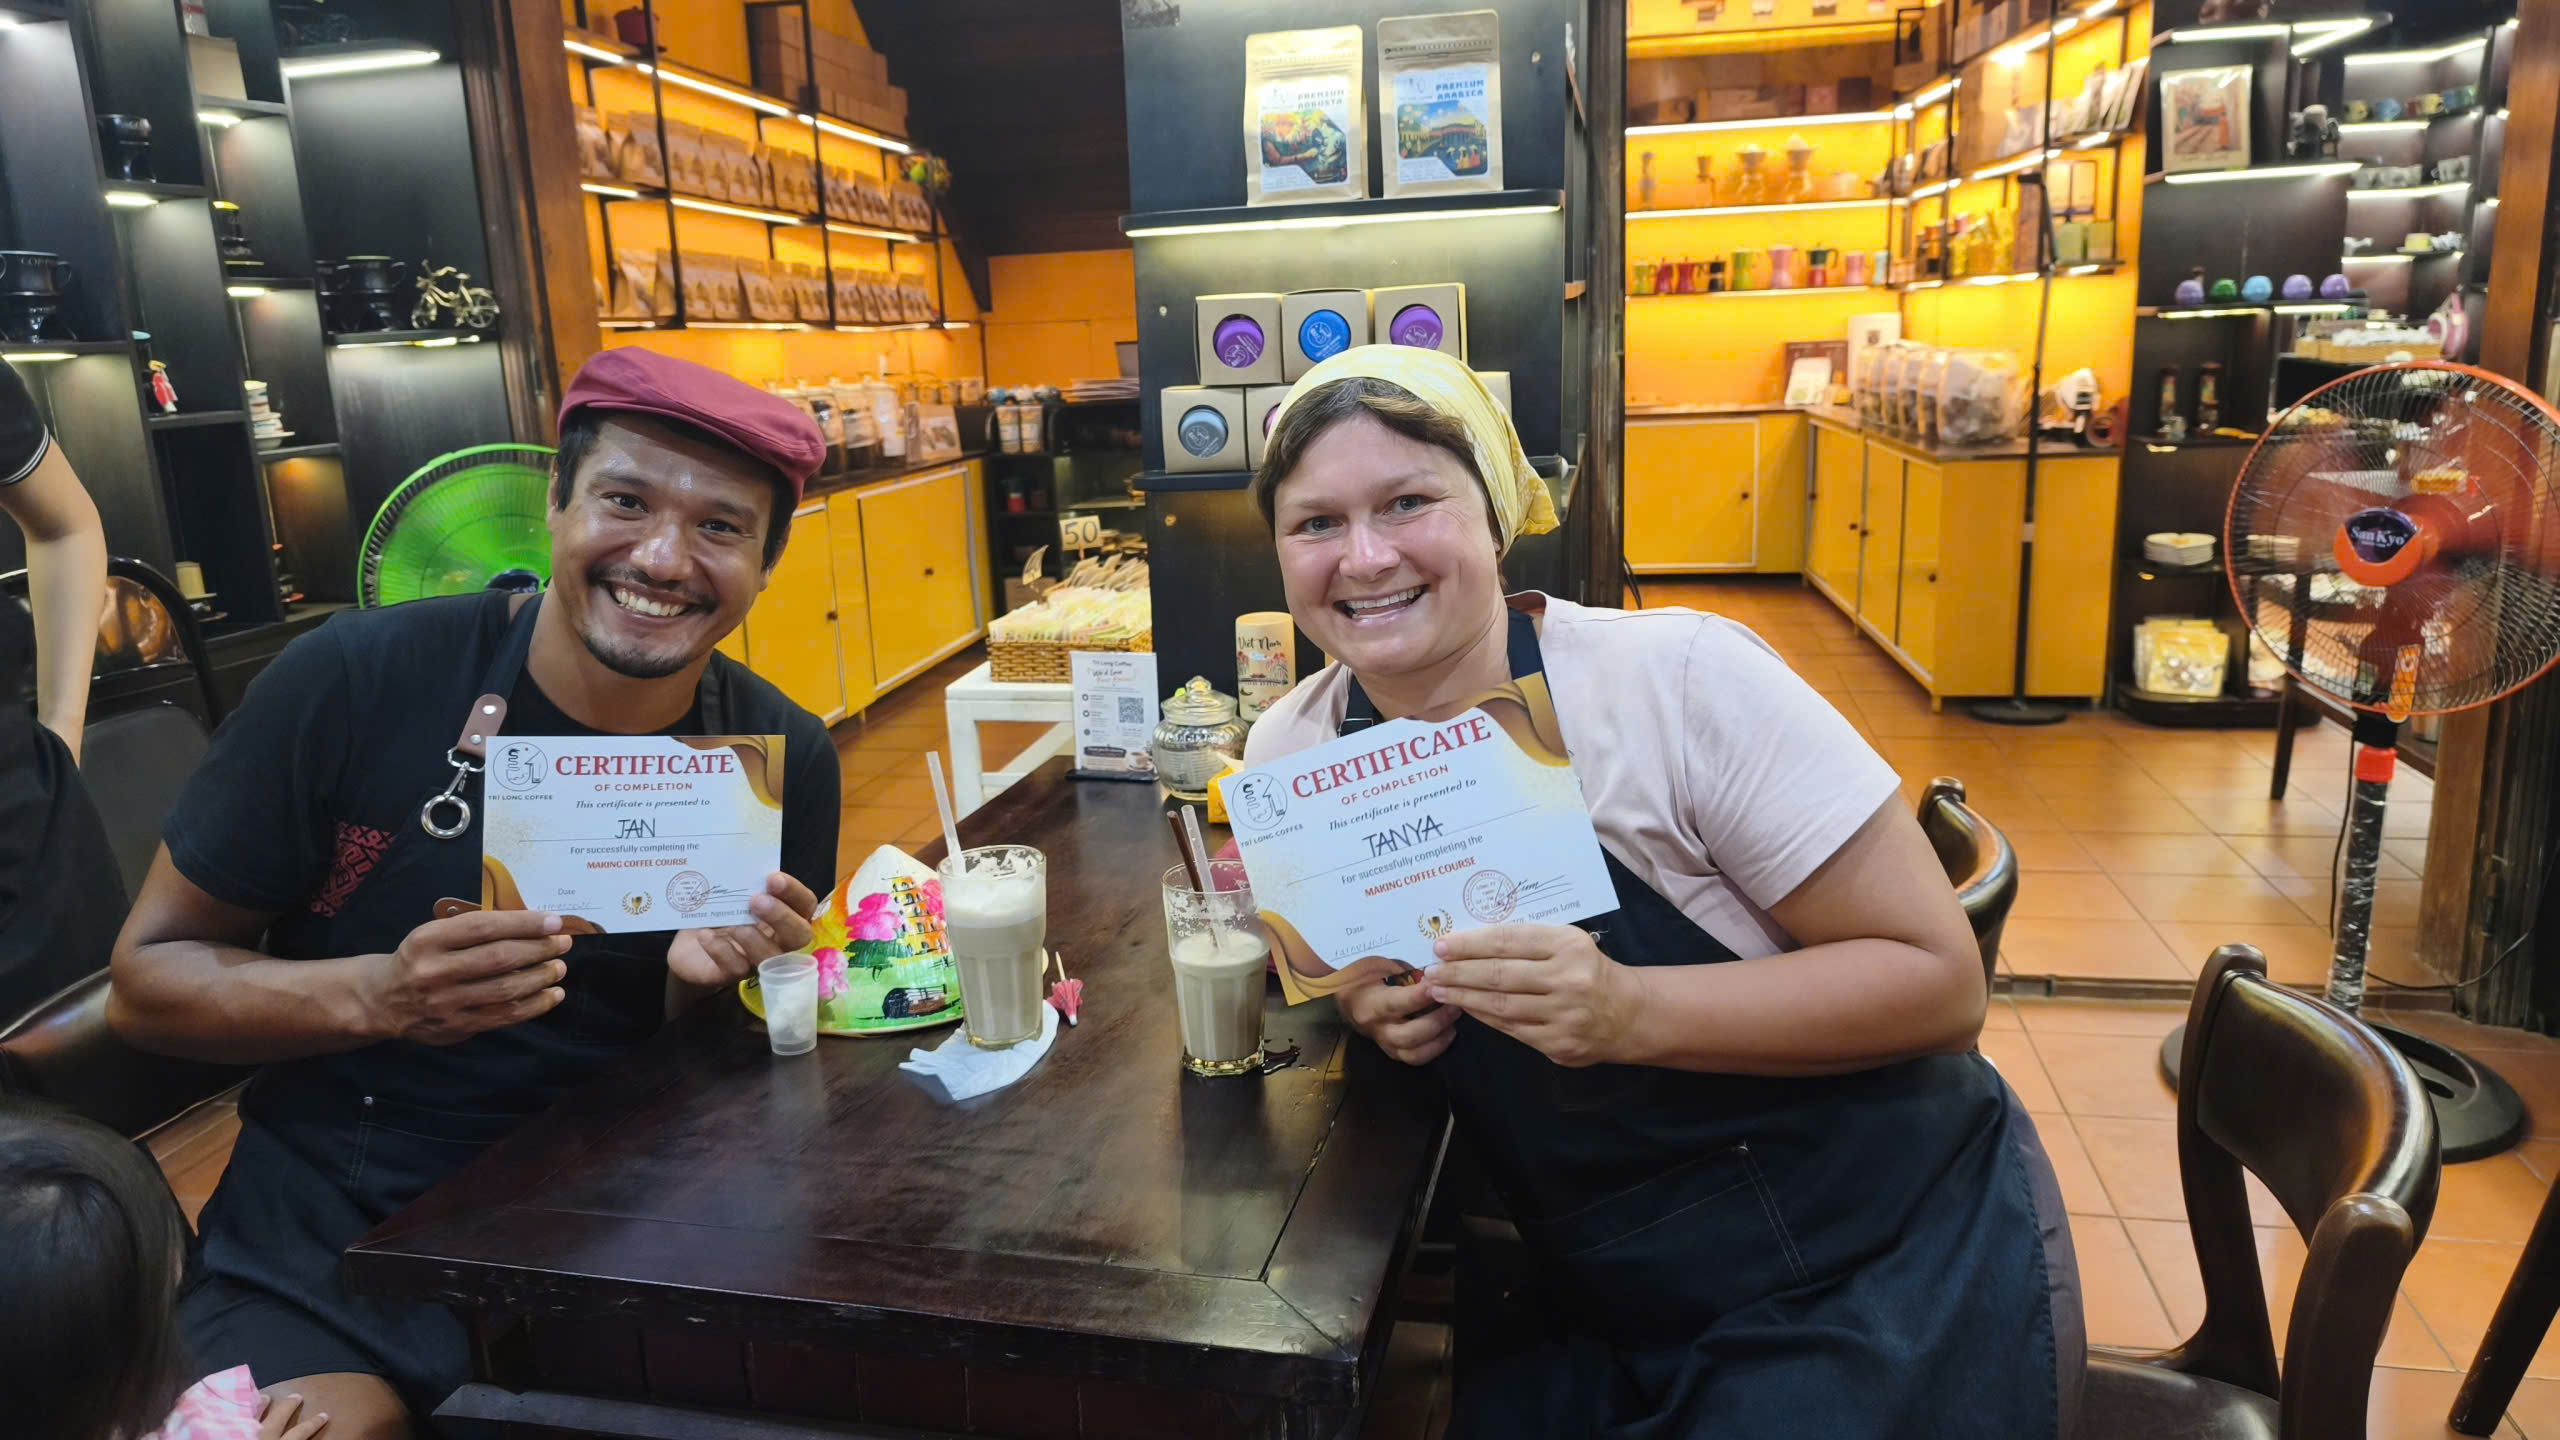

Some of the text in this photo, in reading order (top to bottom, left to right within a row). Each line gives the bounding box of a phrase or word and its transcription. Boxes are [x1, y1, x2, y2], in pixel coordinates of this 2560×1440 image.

[1064, 521, 1097, 545] 50
[555, 754, 735, 776] CERTIFICATE
[1292, 716, 1492, 798] CERTIFICATE
[594, 782, 693, 792] OF COMPLETION
[1341, 764, 1449, 806] OF COMPLETION
[576, 800, 594, 809] This
[597, 799, 643, 810] certificate
[646, 799, 653, 808] is
[655, 798, 699, 809] presented
[1329, 779, 1477, 832] This certificate is presented to
[615, 817, 656, 839] JAN
[1362, 815, 1444, 858] TANYA
[570, 842, 699, 854] For successfully completing the
[587, 858, 688, 870] MAKING COFFEE COURSE
[1341, 834, 1483, 885] For successfully completing the
[1365, 856, 1477, 897] MAKING COFFEE COURSE
[557, 888, 577, 896] Date
[1345, 925, 1365, 936] Date
